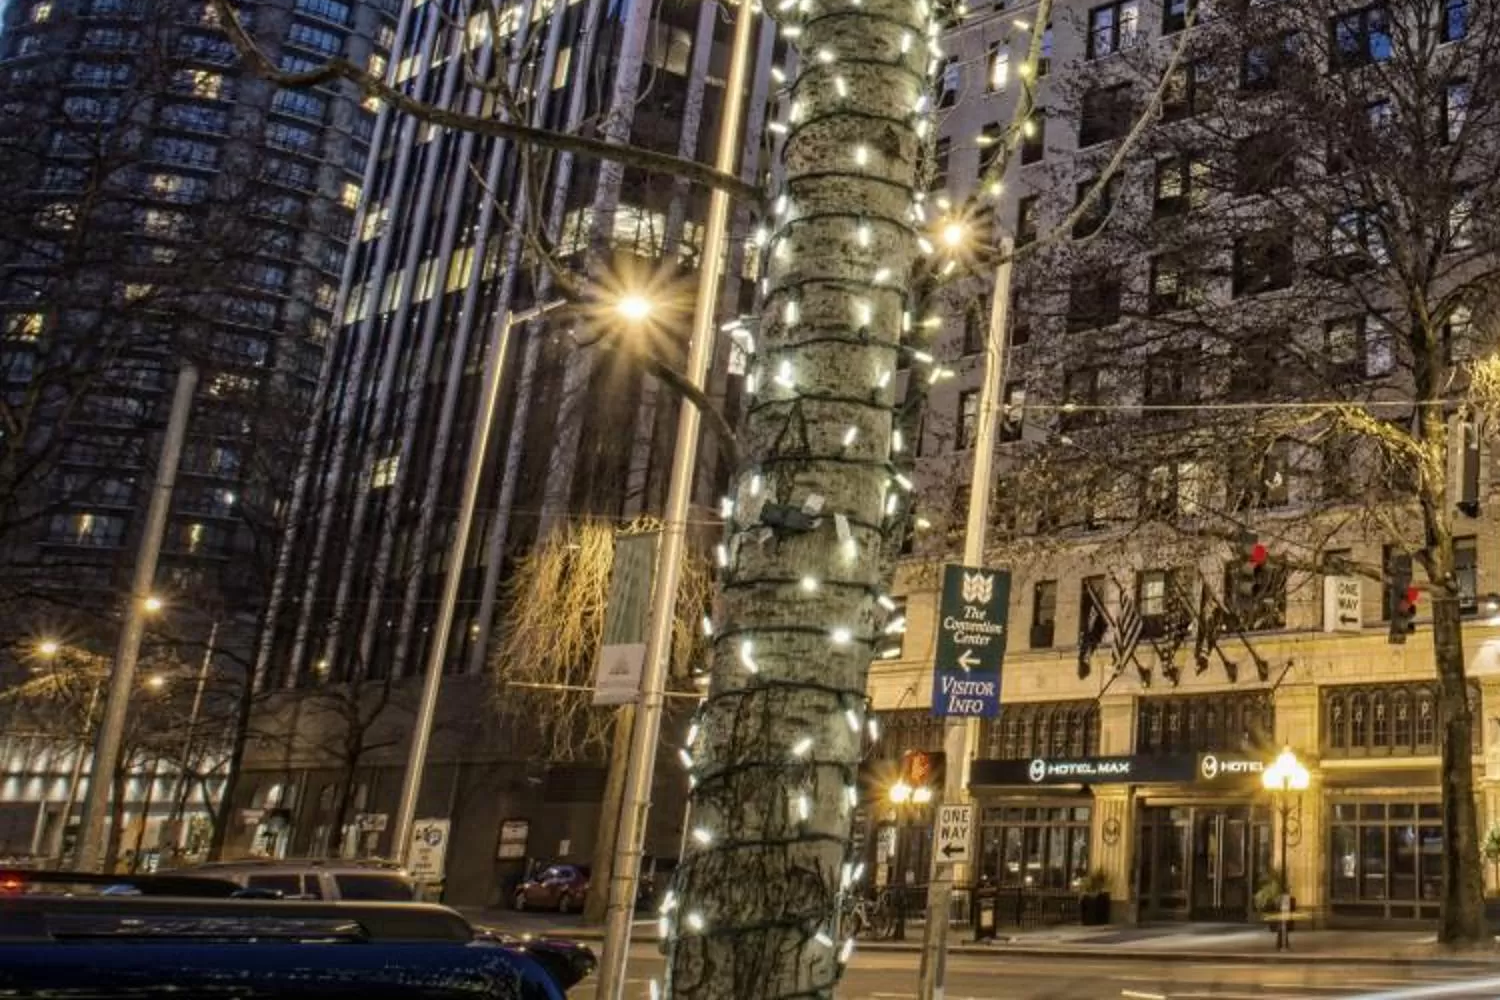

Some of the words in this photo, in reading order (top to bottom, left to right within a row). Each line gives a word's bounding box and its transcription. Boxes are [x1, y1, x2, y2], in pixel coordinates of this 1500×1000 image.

[1338, 582, 1358, 596] ONE
[1338, 598, 1358, 610] WAY
[963, 606, 986, 619] The
[943, 616, 1003, 634] Convention
[953, 631, 992, 645] Center
[947, 697, 984, 713] INFO
[1047, 762, 1096, 775] HOTEL
[1097, 761, 1130, 774] MAX
[1221, 761, 1264, 772] HOTEL
[943, 808, 969, 823] ONE
[941, 825, 968, 840] WAY
